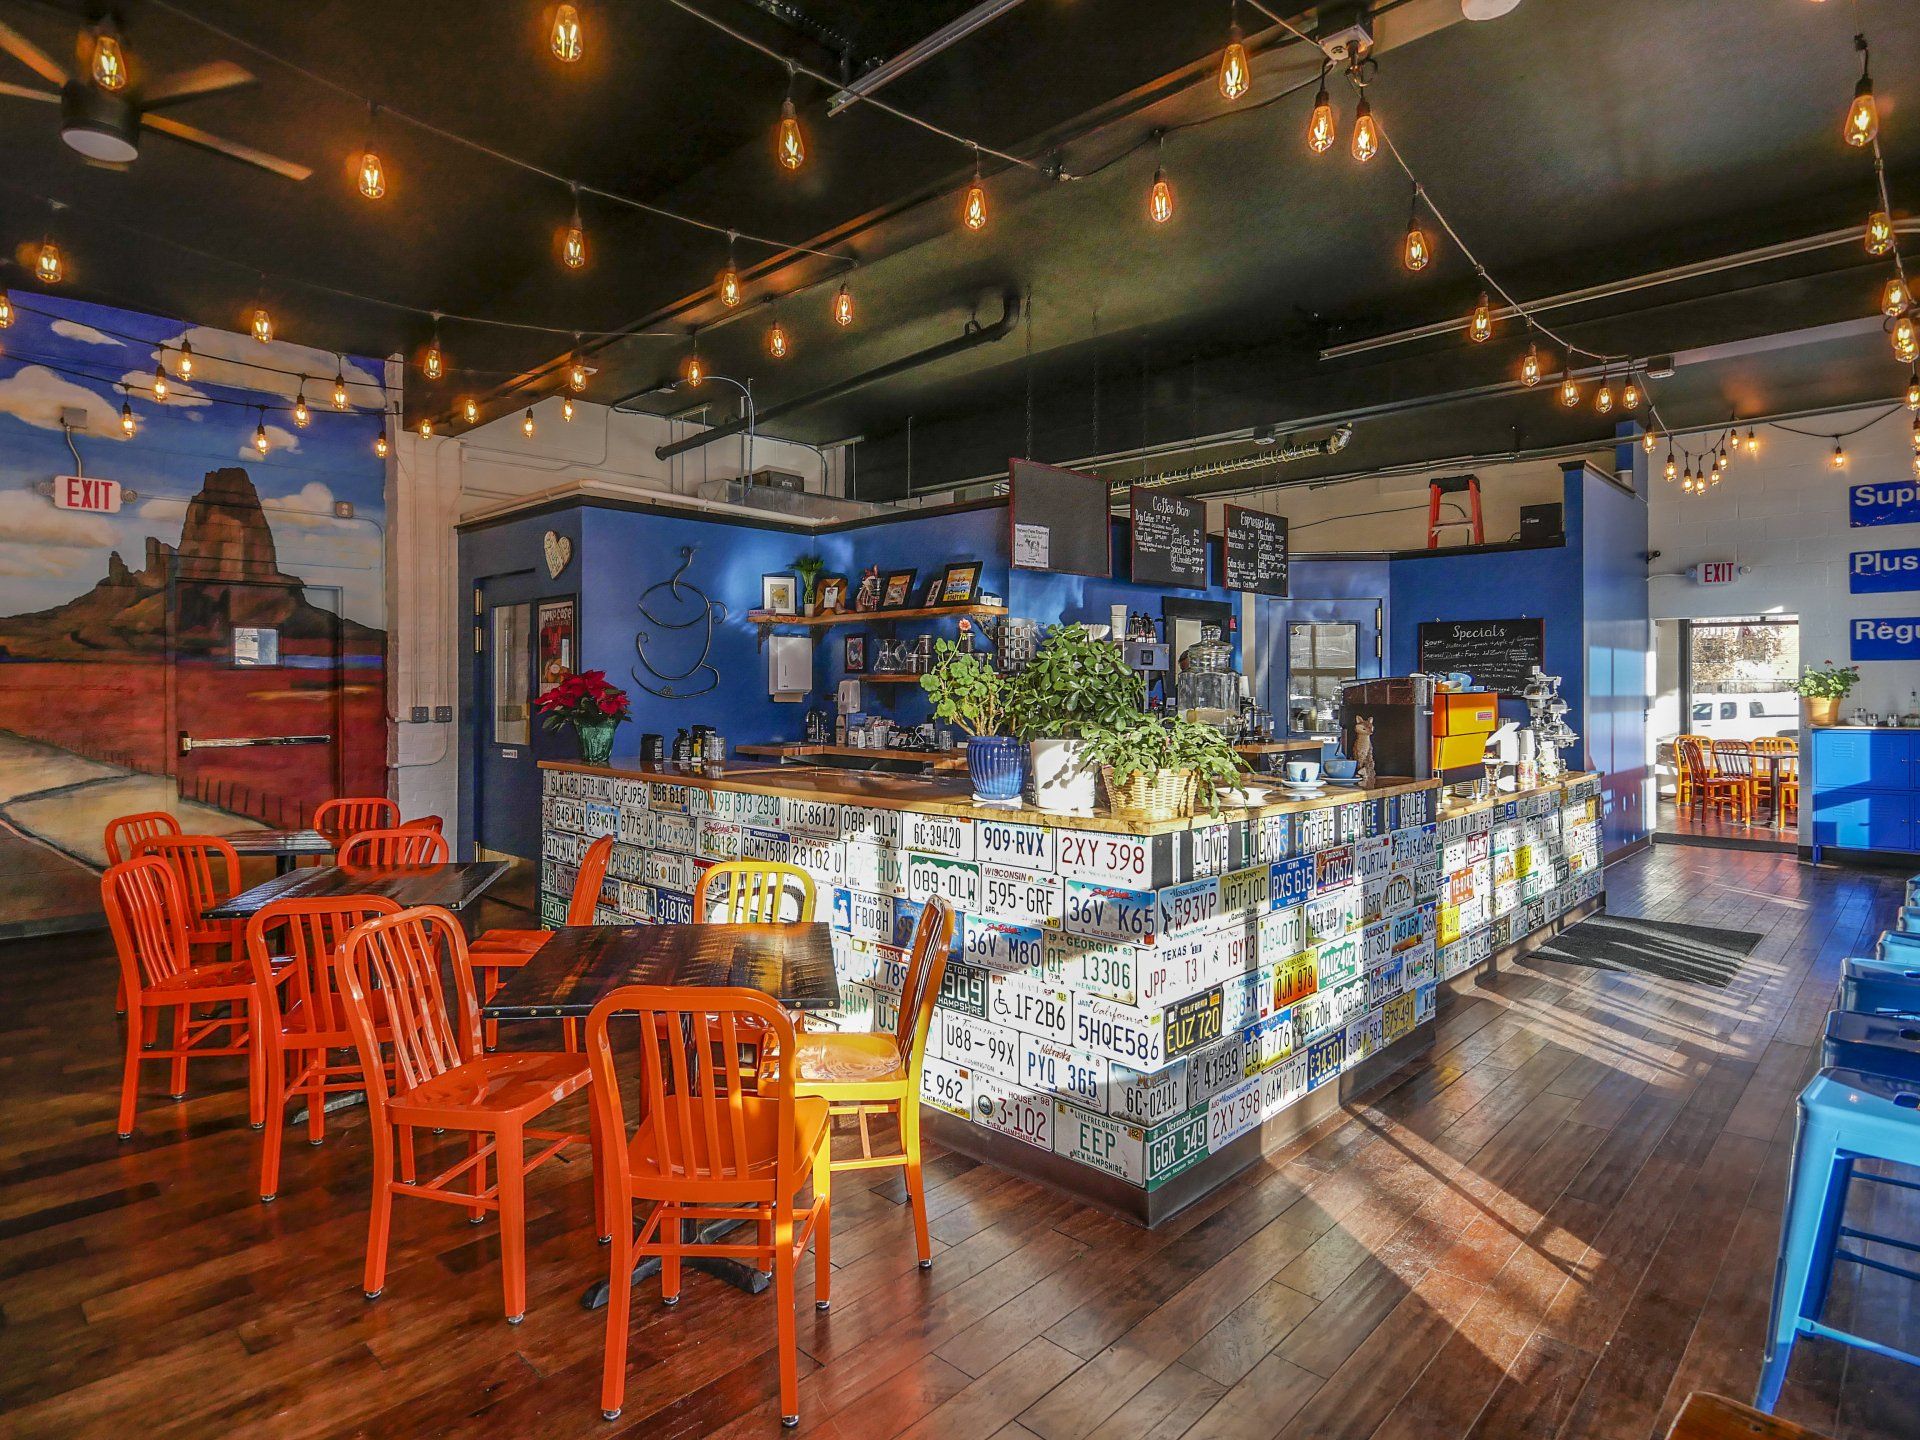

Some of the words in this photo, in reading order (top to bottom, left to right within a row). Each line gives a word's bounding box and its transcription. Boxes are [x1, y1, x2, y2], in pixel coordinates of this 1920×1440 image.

[67, 478, 113, 510] EXIT
[1153, 496, 1175, 514] Coffee
[1176, 501, 1190, 517] Bar
[1240, 511, 1264, 529] Espresso
[1265, 517, 1275, 533] Bar
[1704, 563, 1734, 582] EXIT
[1855, 553, 1918, 573] Plus
[1453, 624, 1507, 640] Specials
[804, 838, 829, 849] MAINE
[1061, 836, 1099, 867] 2XY
[1106, 842, 1145, 875] 398
[1272, 873, 1292, 901] RXS
[1294, 866, 1313, 893] 615
[853, 893, 878, 906] TEXAS
[1069, 896, 1104, 926] 36V
[1118, 904, 1154, 935] K65
[967, 929, 997, 957] 36V
[1008, 937, 1040, 968] M80
[1066, 936, 1114, 955] GEORGIA
[1161, 945, 1187, 962] TEXAS
[1082, 954, 1130, 990] 13306
[1145, 968, 1167, 999] JPP
[1297, 965, 1313, 993] 978
[1015, 993, 1066, 1031] 1F2B6
[1092, 1002, 1149, 1028] California
[1079, 1014, 1159, 1060] 5HQE586
[1167, 1016, 1194, 1054] EUZ
[1198, 1007, 1219, 1040] 720
[1040, 1044, 1072, 1063] Nebraska
[936, 1074, 963, 1103] 962
[1028, 1051, 1055, 1089] PYQ
[1067, 1064, 1097, 1098] 365
[1008, 1091, 1032, 1106] HOUSE
[1166, 1114, 1192, 1133] Vermont
[1212, 1105, 1235, 1140] 2XY
[1238, 1089, 1260, 1123] 398
[1080, 1122, 1116, 1159] EEP
[1153, 1135, 1176, 1172] GGR
[1182, 1119, 1205, 1155] 549
[1086, 1155, 1123, 1175] HAMPSHIRE
